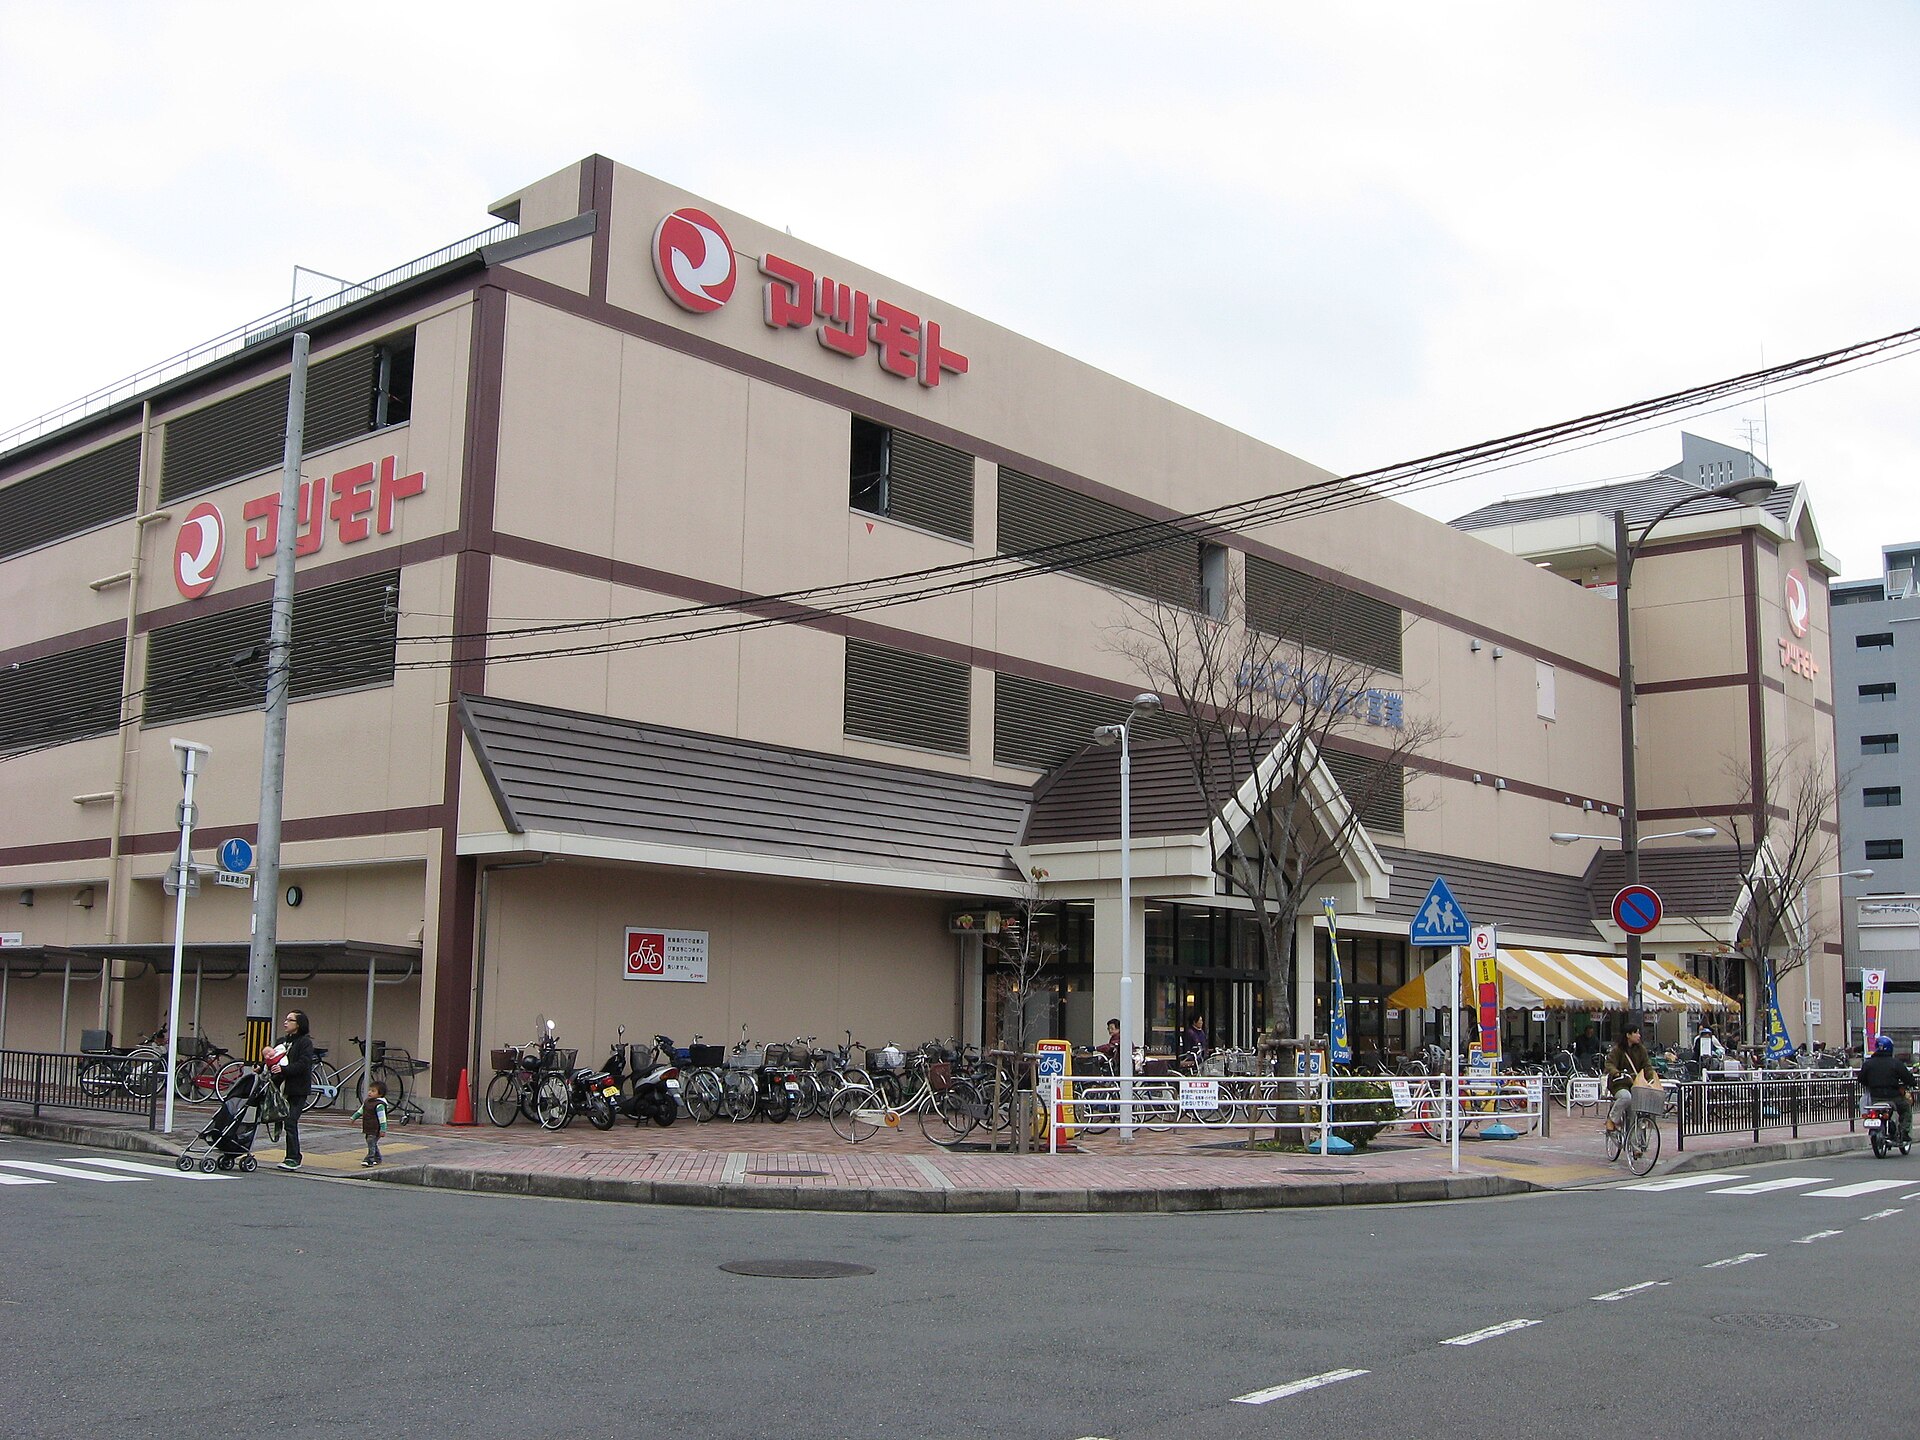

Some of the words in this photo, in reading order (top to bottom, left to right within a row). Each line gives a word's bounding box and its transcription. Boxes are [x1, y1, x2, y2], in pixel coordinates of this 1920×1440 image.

[759, 252, 969, 388] マツモト
[243, 455, 426, 571] マツモト
[1777, 637, 1820, 682] マツモト
